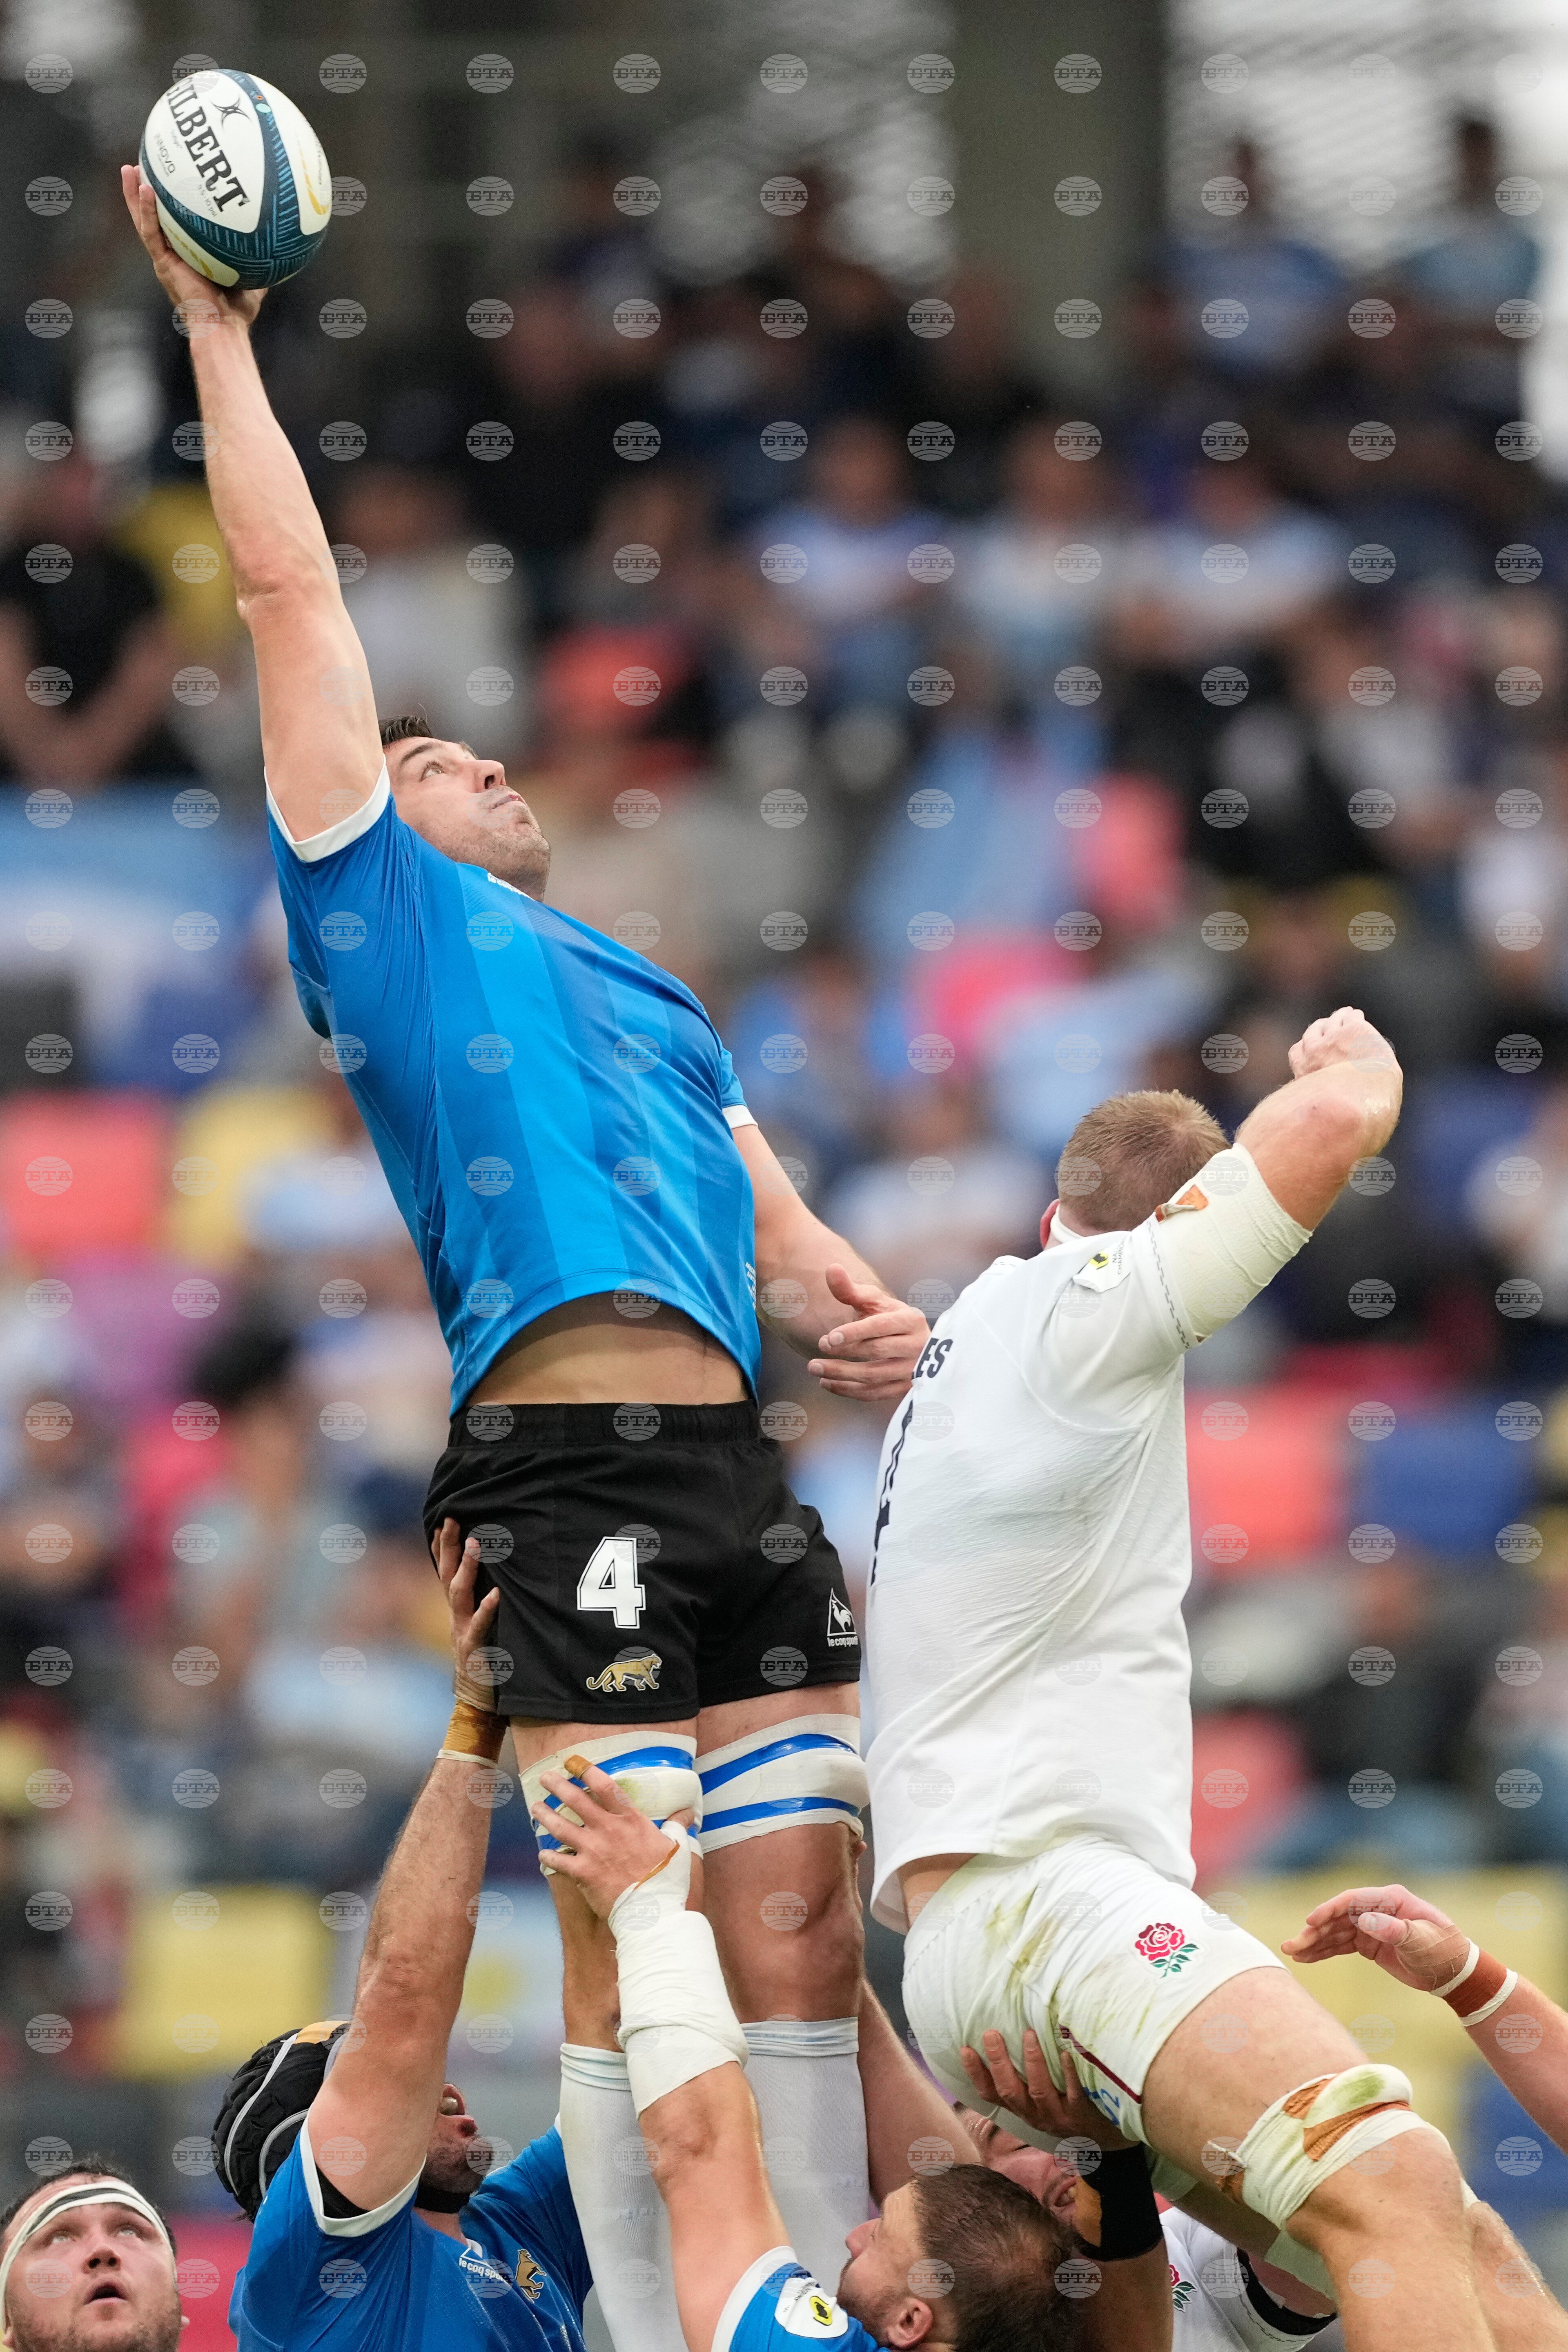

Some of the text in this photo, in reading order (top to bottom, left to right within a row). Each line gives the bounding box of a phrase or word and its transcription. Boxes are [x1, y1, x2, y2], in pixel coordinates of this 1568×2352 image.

[577, 1536, 646, 1629] 4
[459, 2257, 467, 2267] le
[467, 2263, 485, 2276] coq
